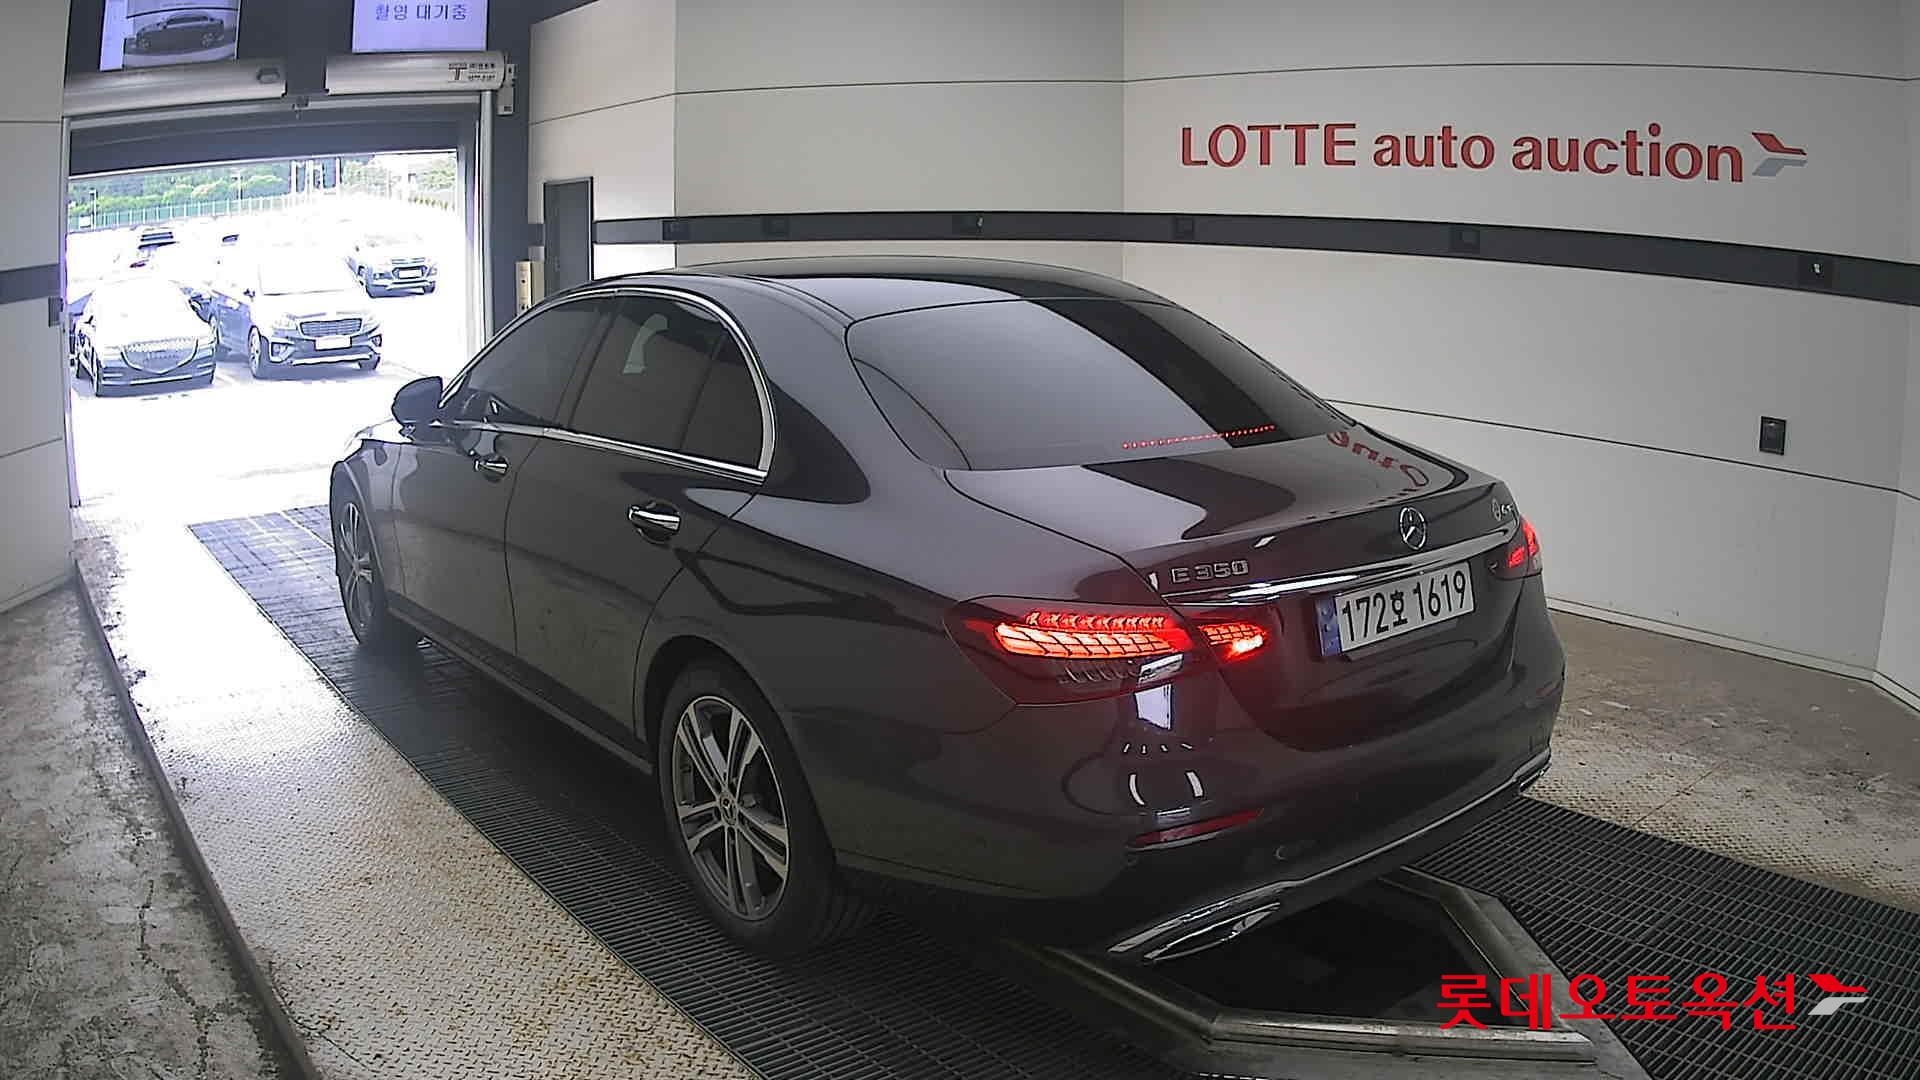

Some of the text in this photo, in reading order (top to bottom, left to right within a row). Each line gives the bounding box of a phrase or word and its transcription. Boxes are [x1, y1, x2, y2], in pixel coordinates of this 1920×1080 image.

[415, 3, 467, 21] 대기중
[1181, 122, 1743, 182] LOTTE auto auction
[1171, 560, 1249, 583] E 350
[1342, 570, 1466, 641] 172호 1619
